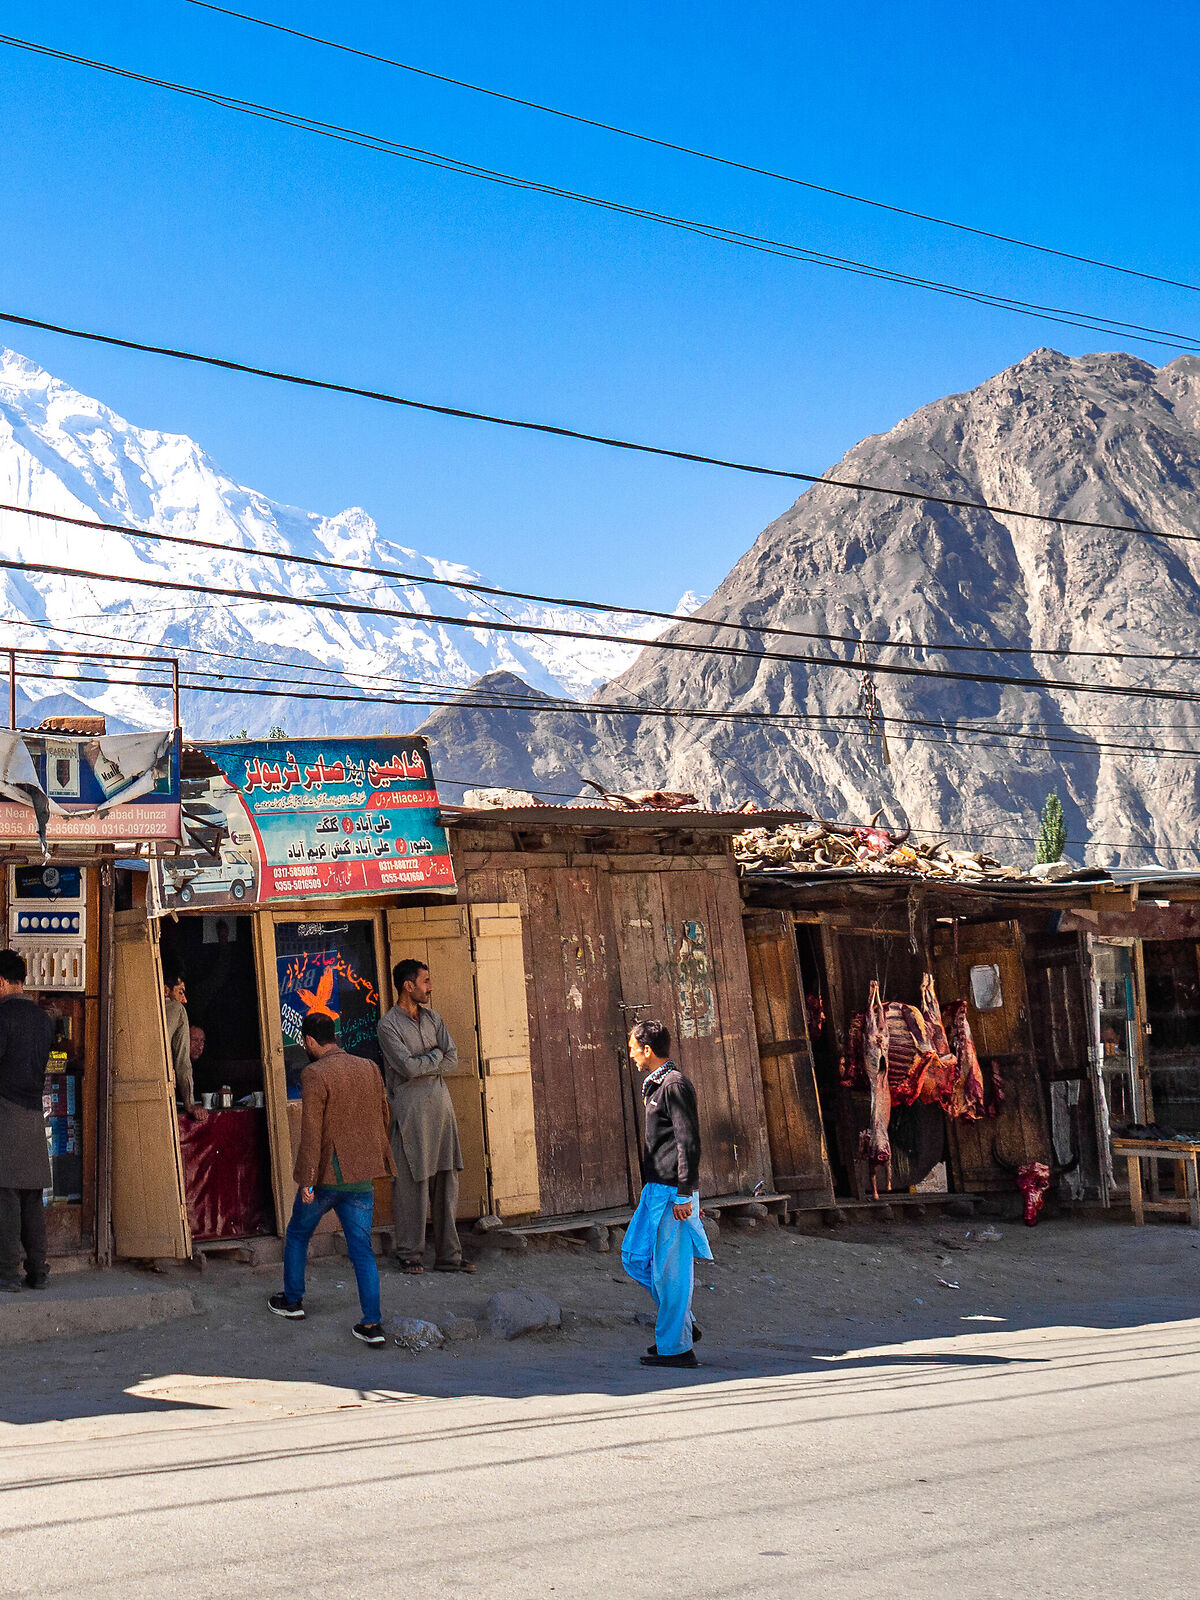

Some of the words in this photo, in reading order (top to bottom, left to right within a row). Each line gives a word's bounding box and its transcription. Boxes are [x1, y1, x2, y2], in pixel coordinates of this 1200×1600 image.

[243, 750, 301, 794] ٹریولز
[302, 754, 346, 794] صابر
[392, 792, 418, 804] Hiace
[5, 806, 30, 819] Near
[136, 809, 167, 820] Hunza
[316, 816, 339, 834] گلگت
[355, 814, 373, 834] آباد
[374, 815, 391, 834] علی
[373, 837, 391, 858] علی
